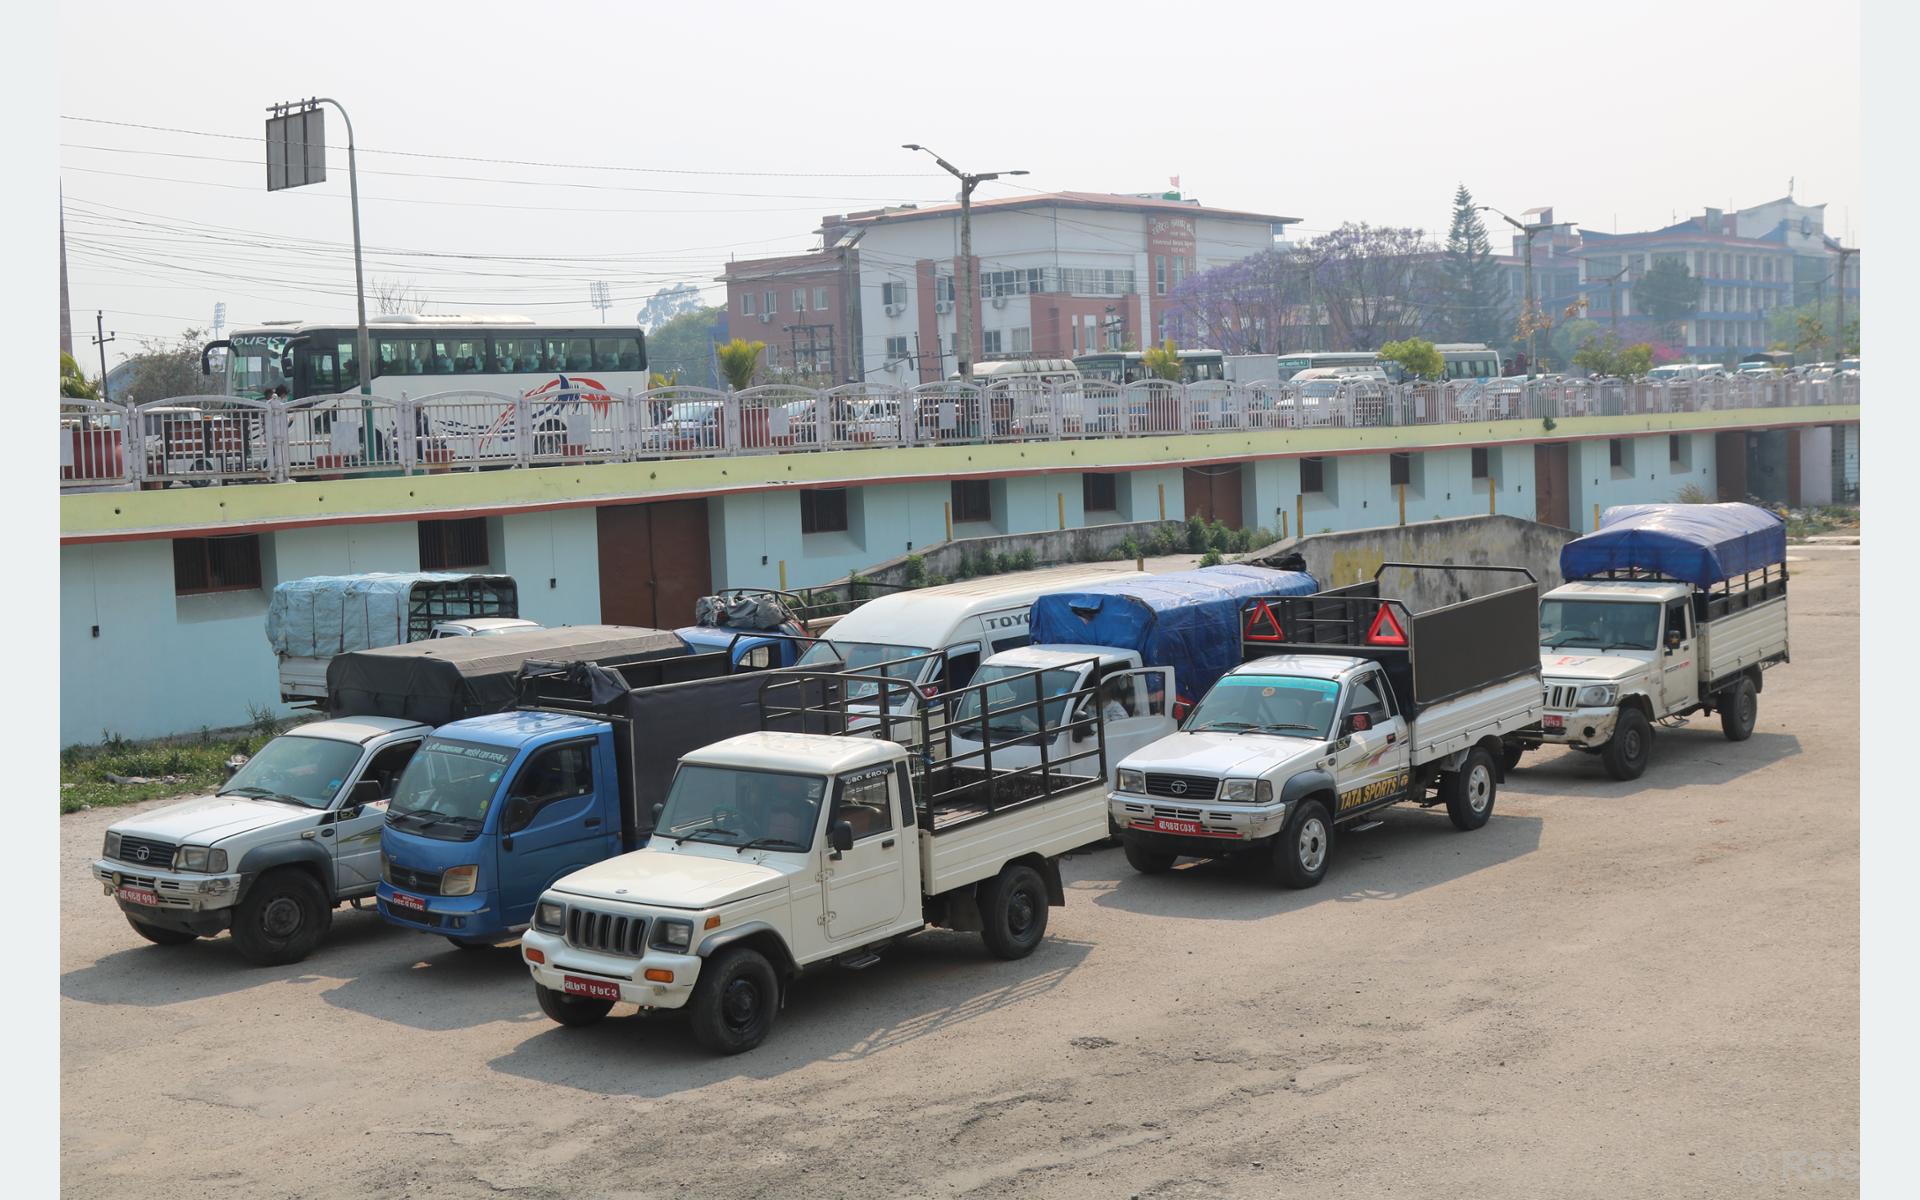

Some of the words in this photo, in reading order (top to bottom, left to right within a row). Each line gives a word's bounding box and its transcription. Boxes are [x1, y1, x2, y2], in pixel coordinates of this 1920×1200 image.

[986, 613, 1030, 629] TOYO
[1340, 787, 1362, 811] TATA
[1363, 777, 1398, 802] SPORTS
